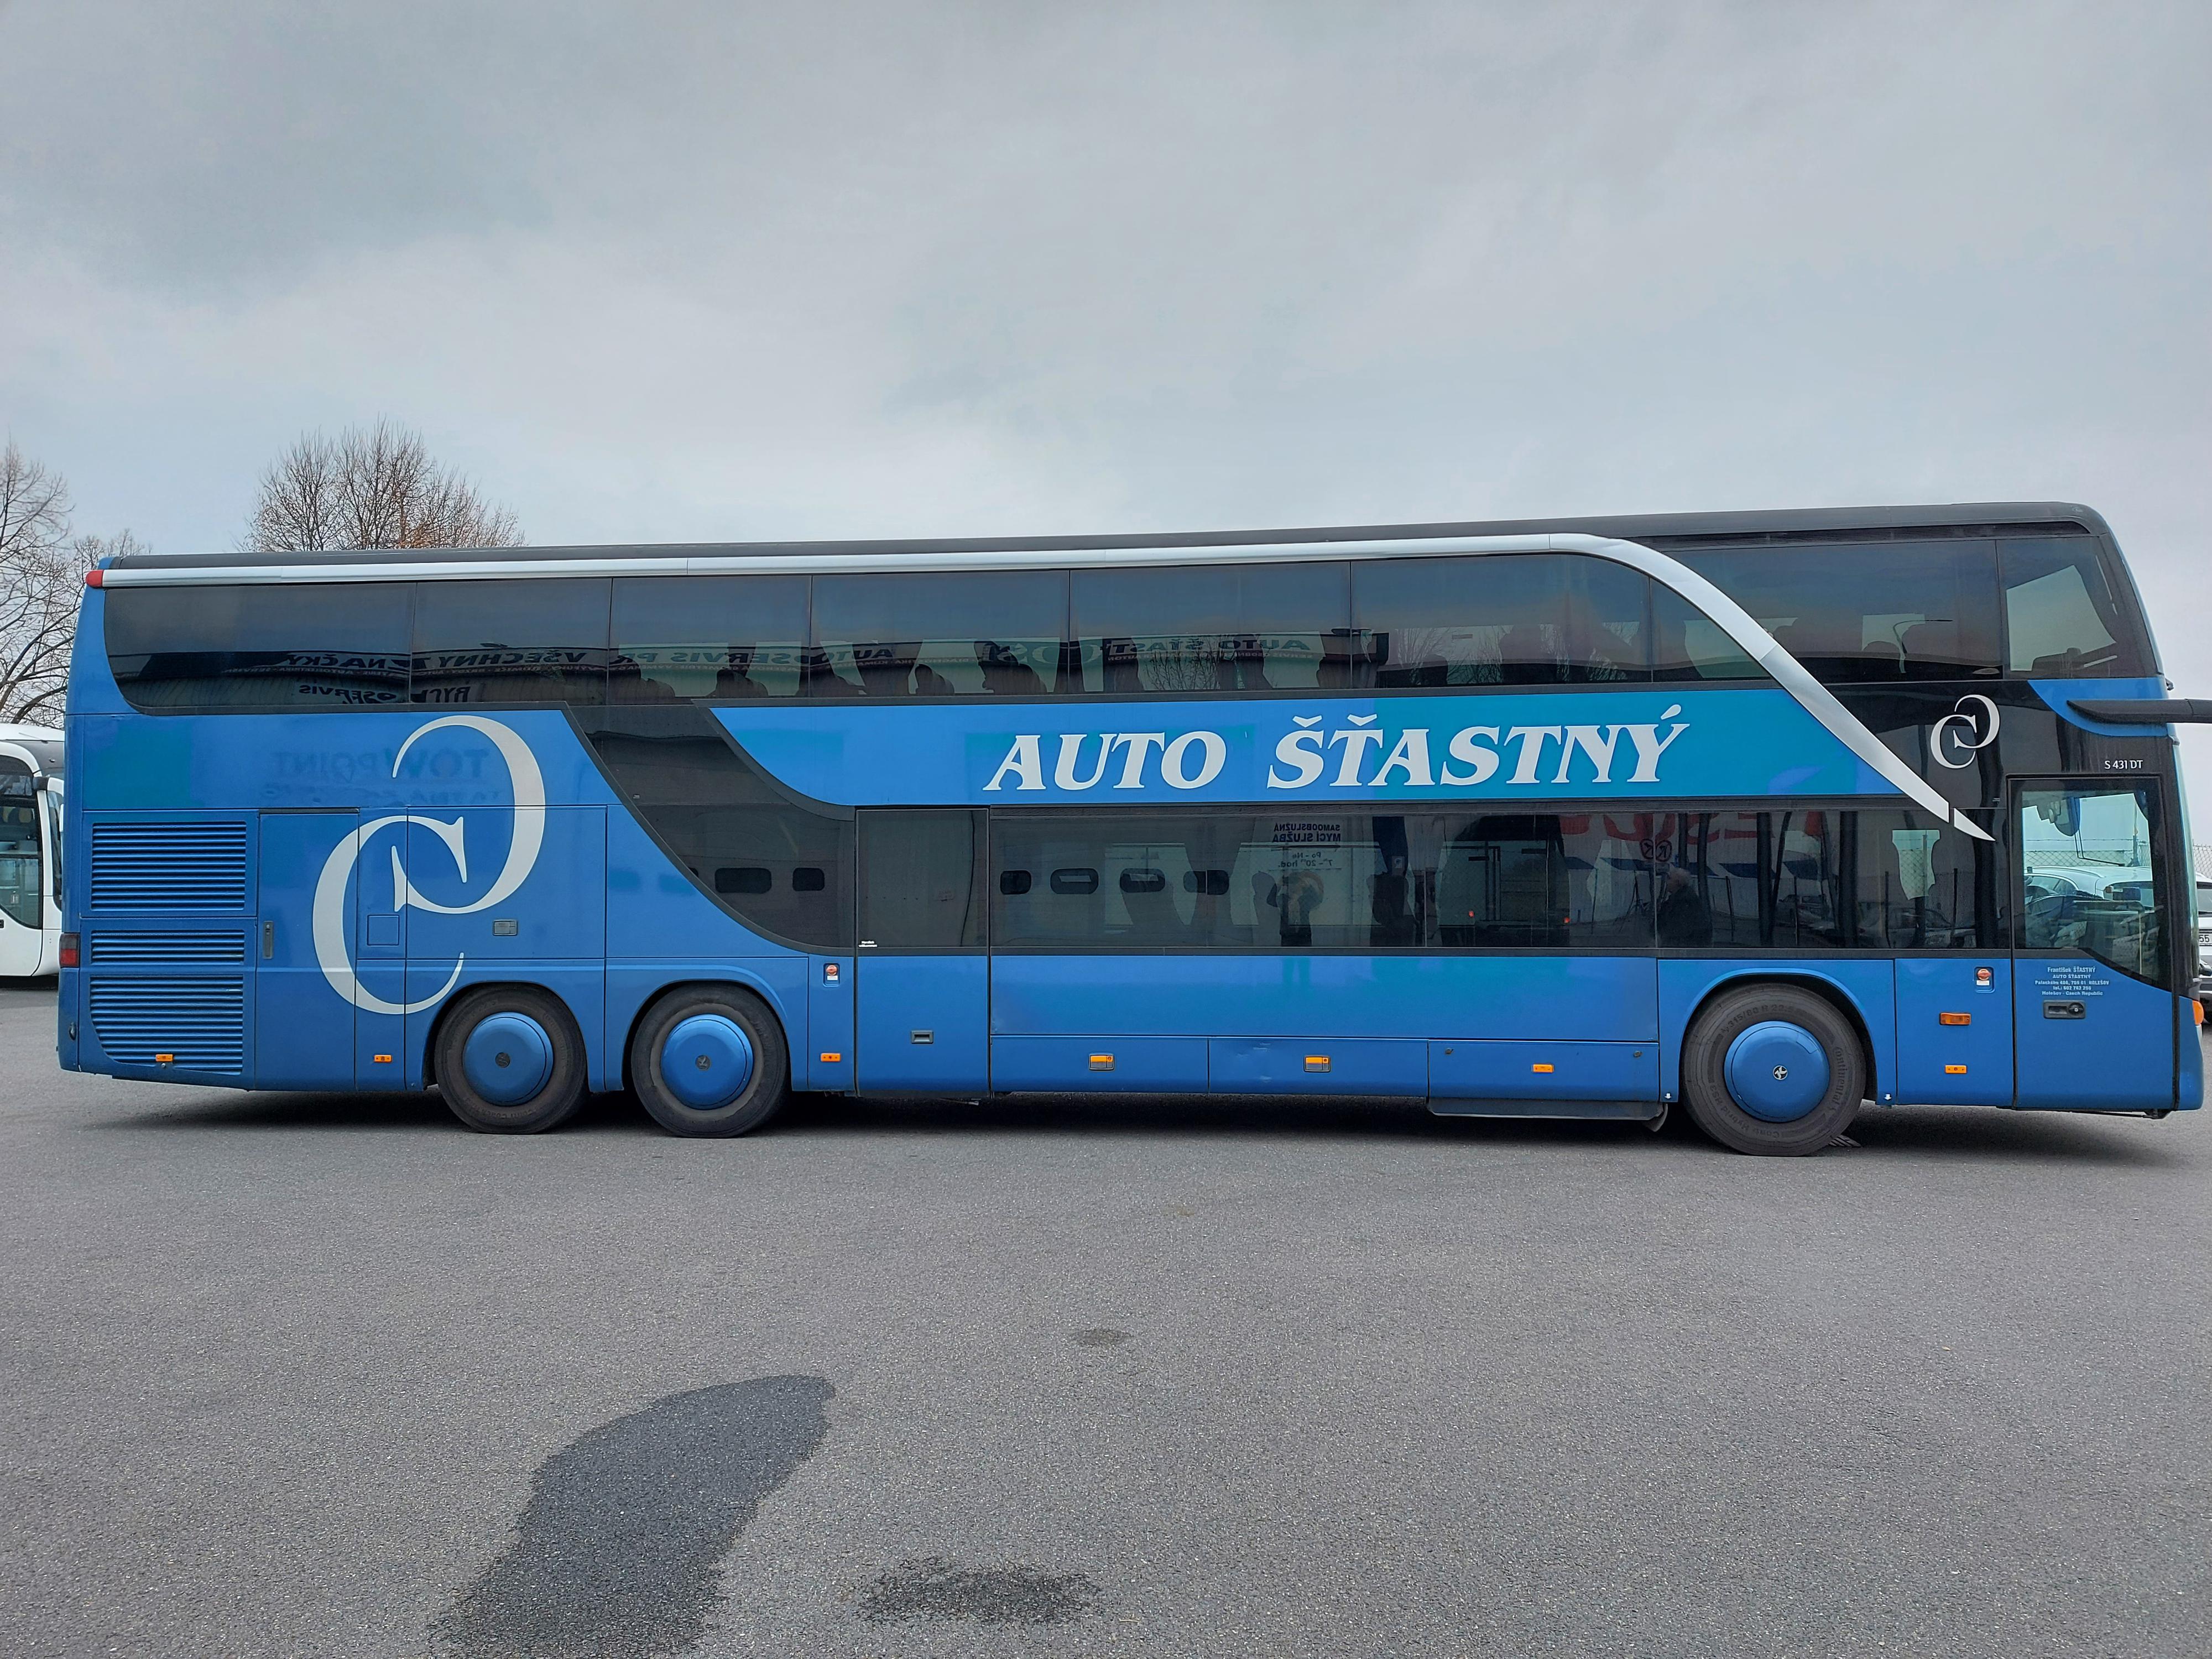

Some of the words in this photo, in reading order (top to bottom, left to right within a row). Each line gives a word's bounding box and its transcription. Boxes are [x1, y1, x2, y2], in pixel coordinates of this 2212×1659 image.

[982, 731, 1227, 791] AUTO
[1266, 704, 1691, 789] ŠŤASTNÝ
[2104, 760, 2111, 769] S
[2112, 760, 2128, 769] 431
[2129, 760, 2143, 769] DT
